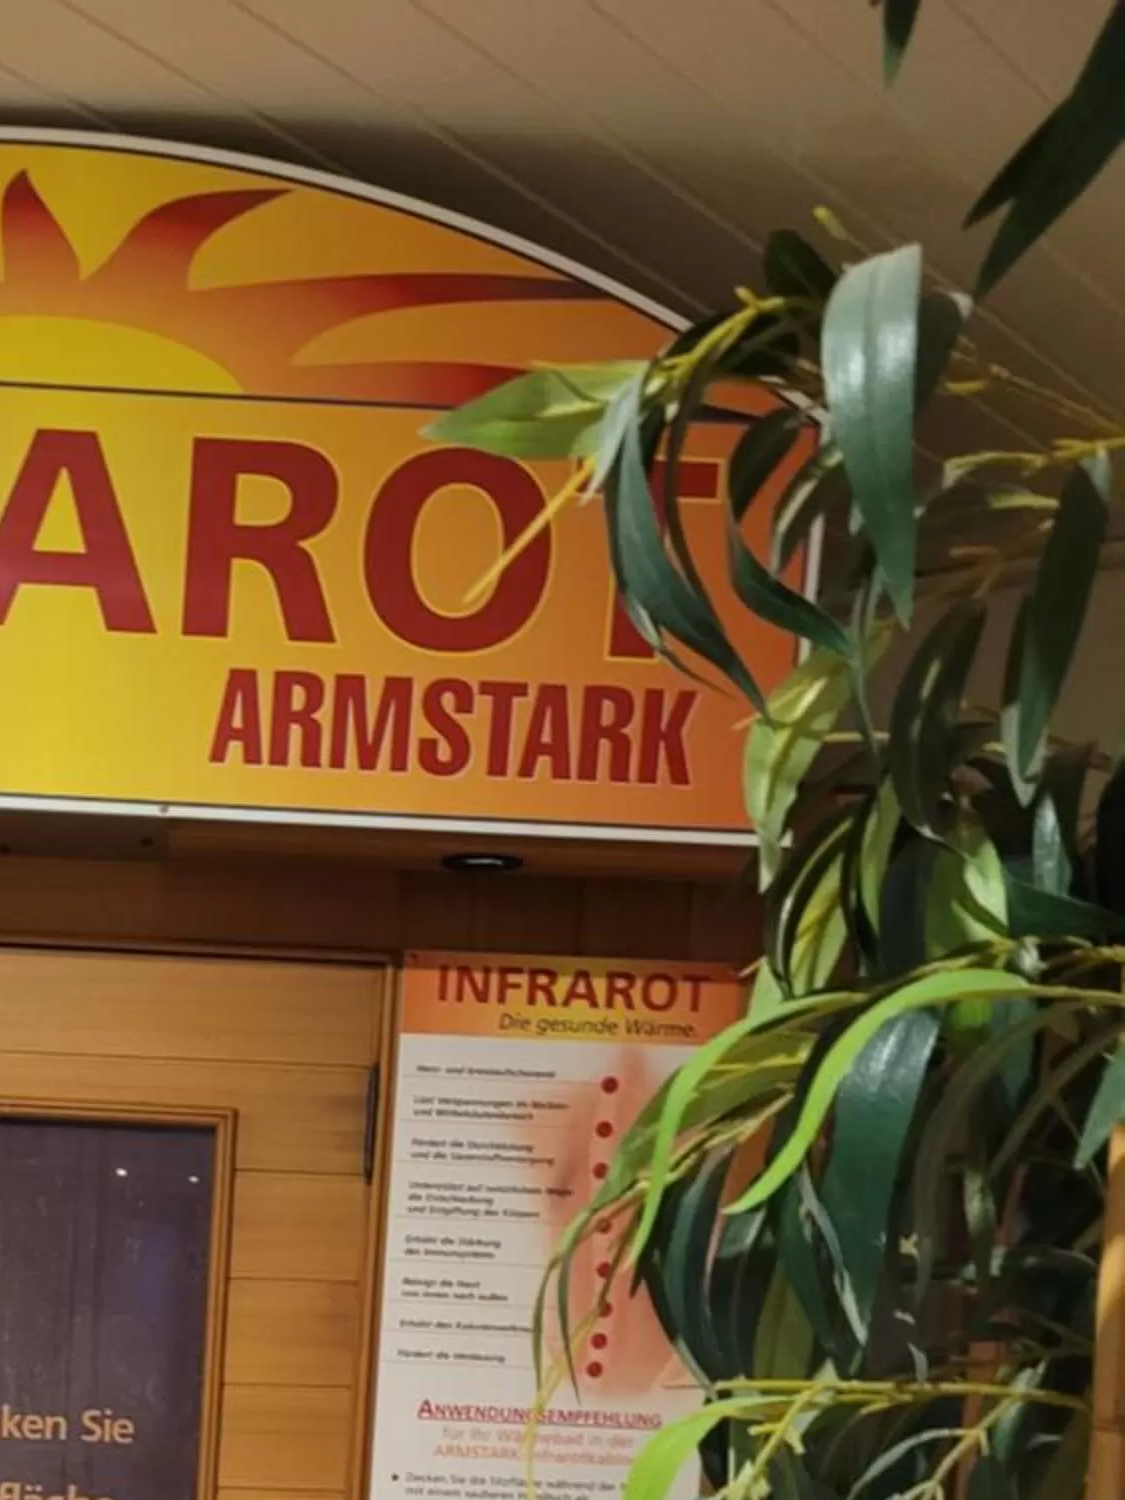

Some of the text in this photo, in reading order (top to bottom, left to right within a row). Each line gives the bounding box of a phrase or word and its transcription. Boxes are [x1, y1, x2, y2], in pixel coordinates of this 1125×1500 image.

[208, 669, 697, 786] ARMSTARK
[438, 964, 711, 1012] INFRAROT
[498, 1012, 696, 1038] Die gesunde Wärme.
[80, 1409, 134, 1444] Sie
